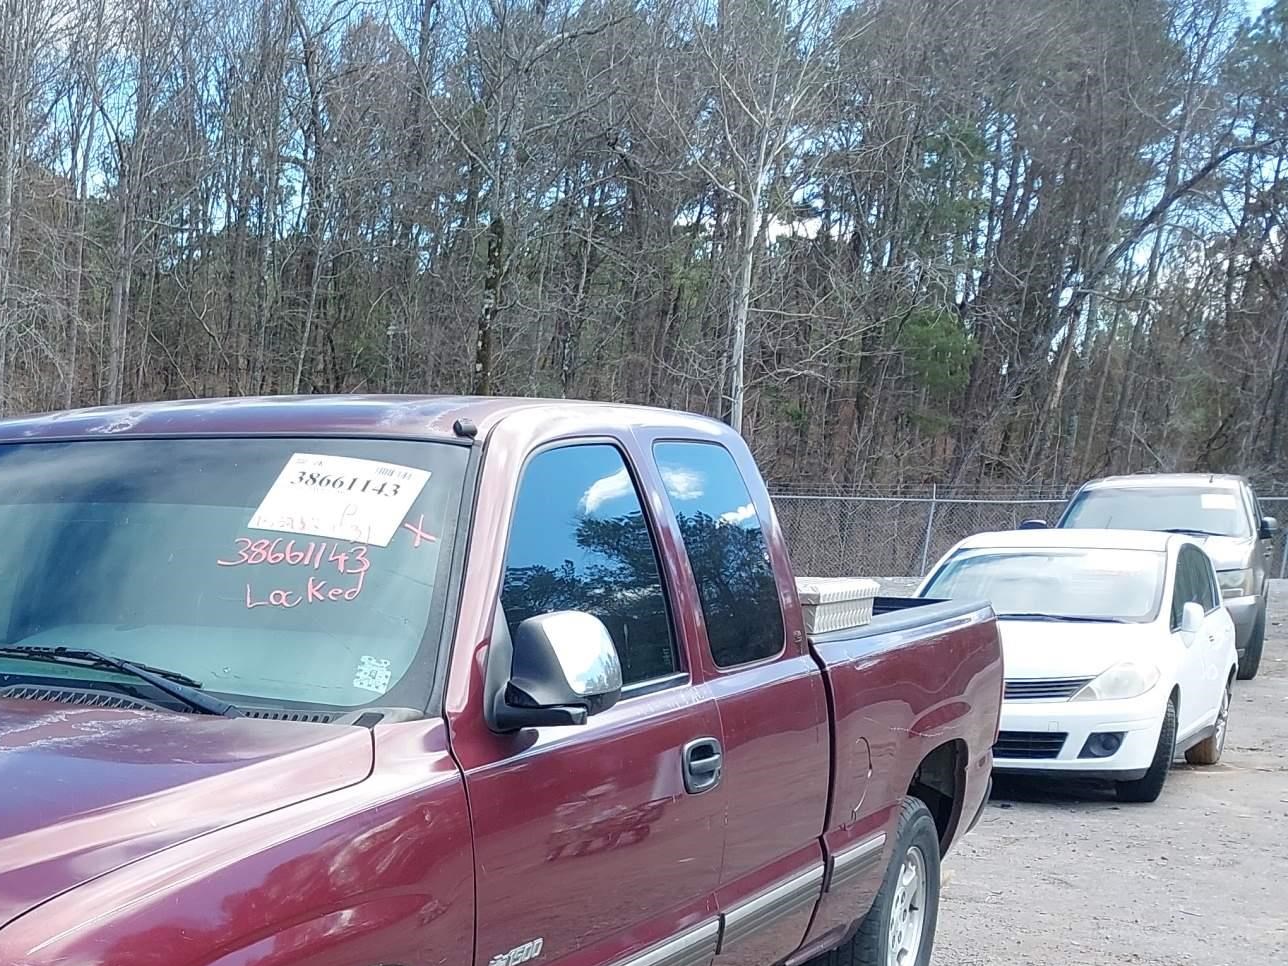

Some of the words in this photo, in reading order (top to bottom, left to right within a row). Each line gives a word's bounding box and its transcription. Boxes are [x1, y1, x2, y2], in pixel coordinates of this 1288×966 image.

[290, 470, 402, 498] 38661143
[216, 537, 371, 574] 38661143
[246, 573, 366, 609] Locked
